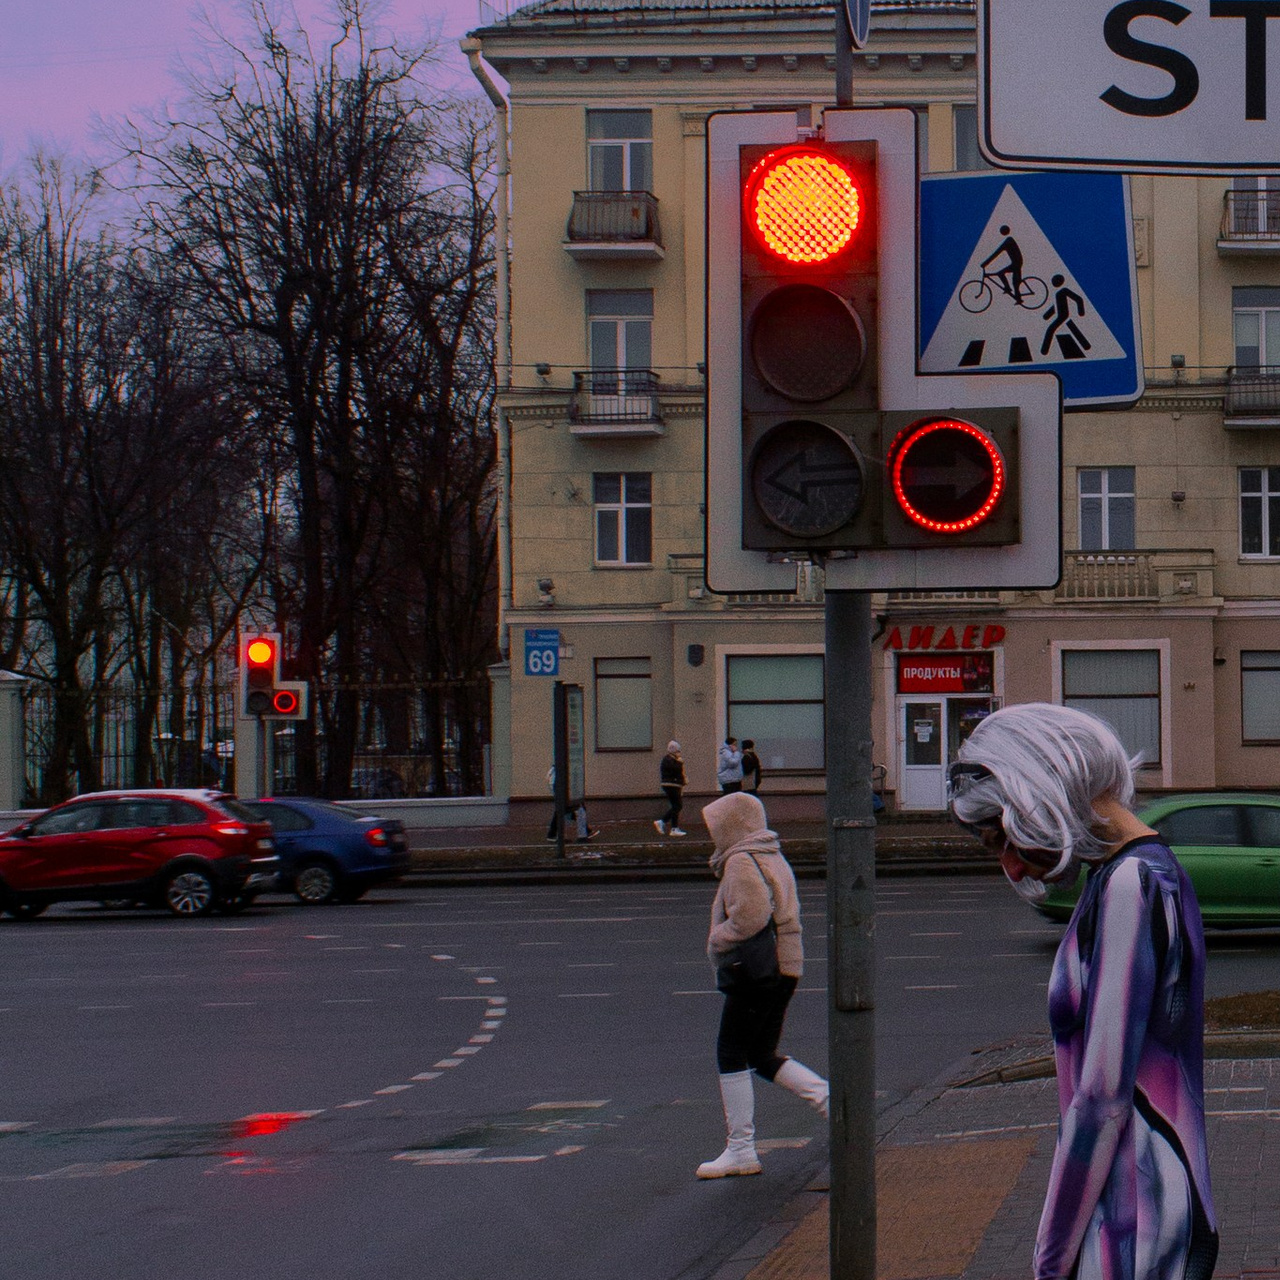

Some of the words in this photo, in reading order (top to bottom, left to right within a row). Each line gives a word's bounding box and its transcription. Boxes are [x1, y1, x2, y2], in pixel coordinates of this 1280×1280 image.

[883, 625, 1006, 650] ЛИДЕР
[528, 649, 556, 673] 69
[903, 667, 961, 680] ПРОДУКТЫ
